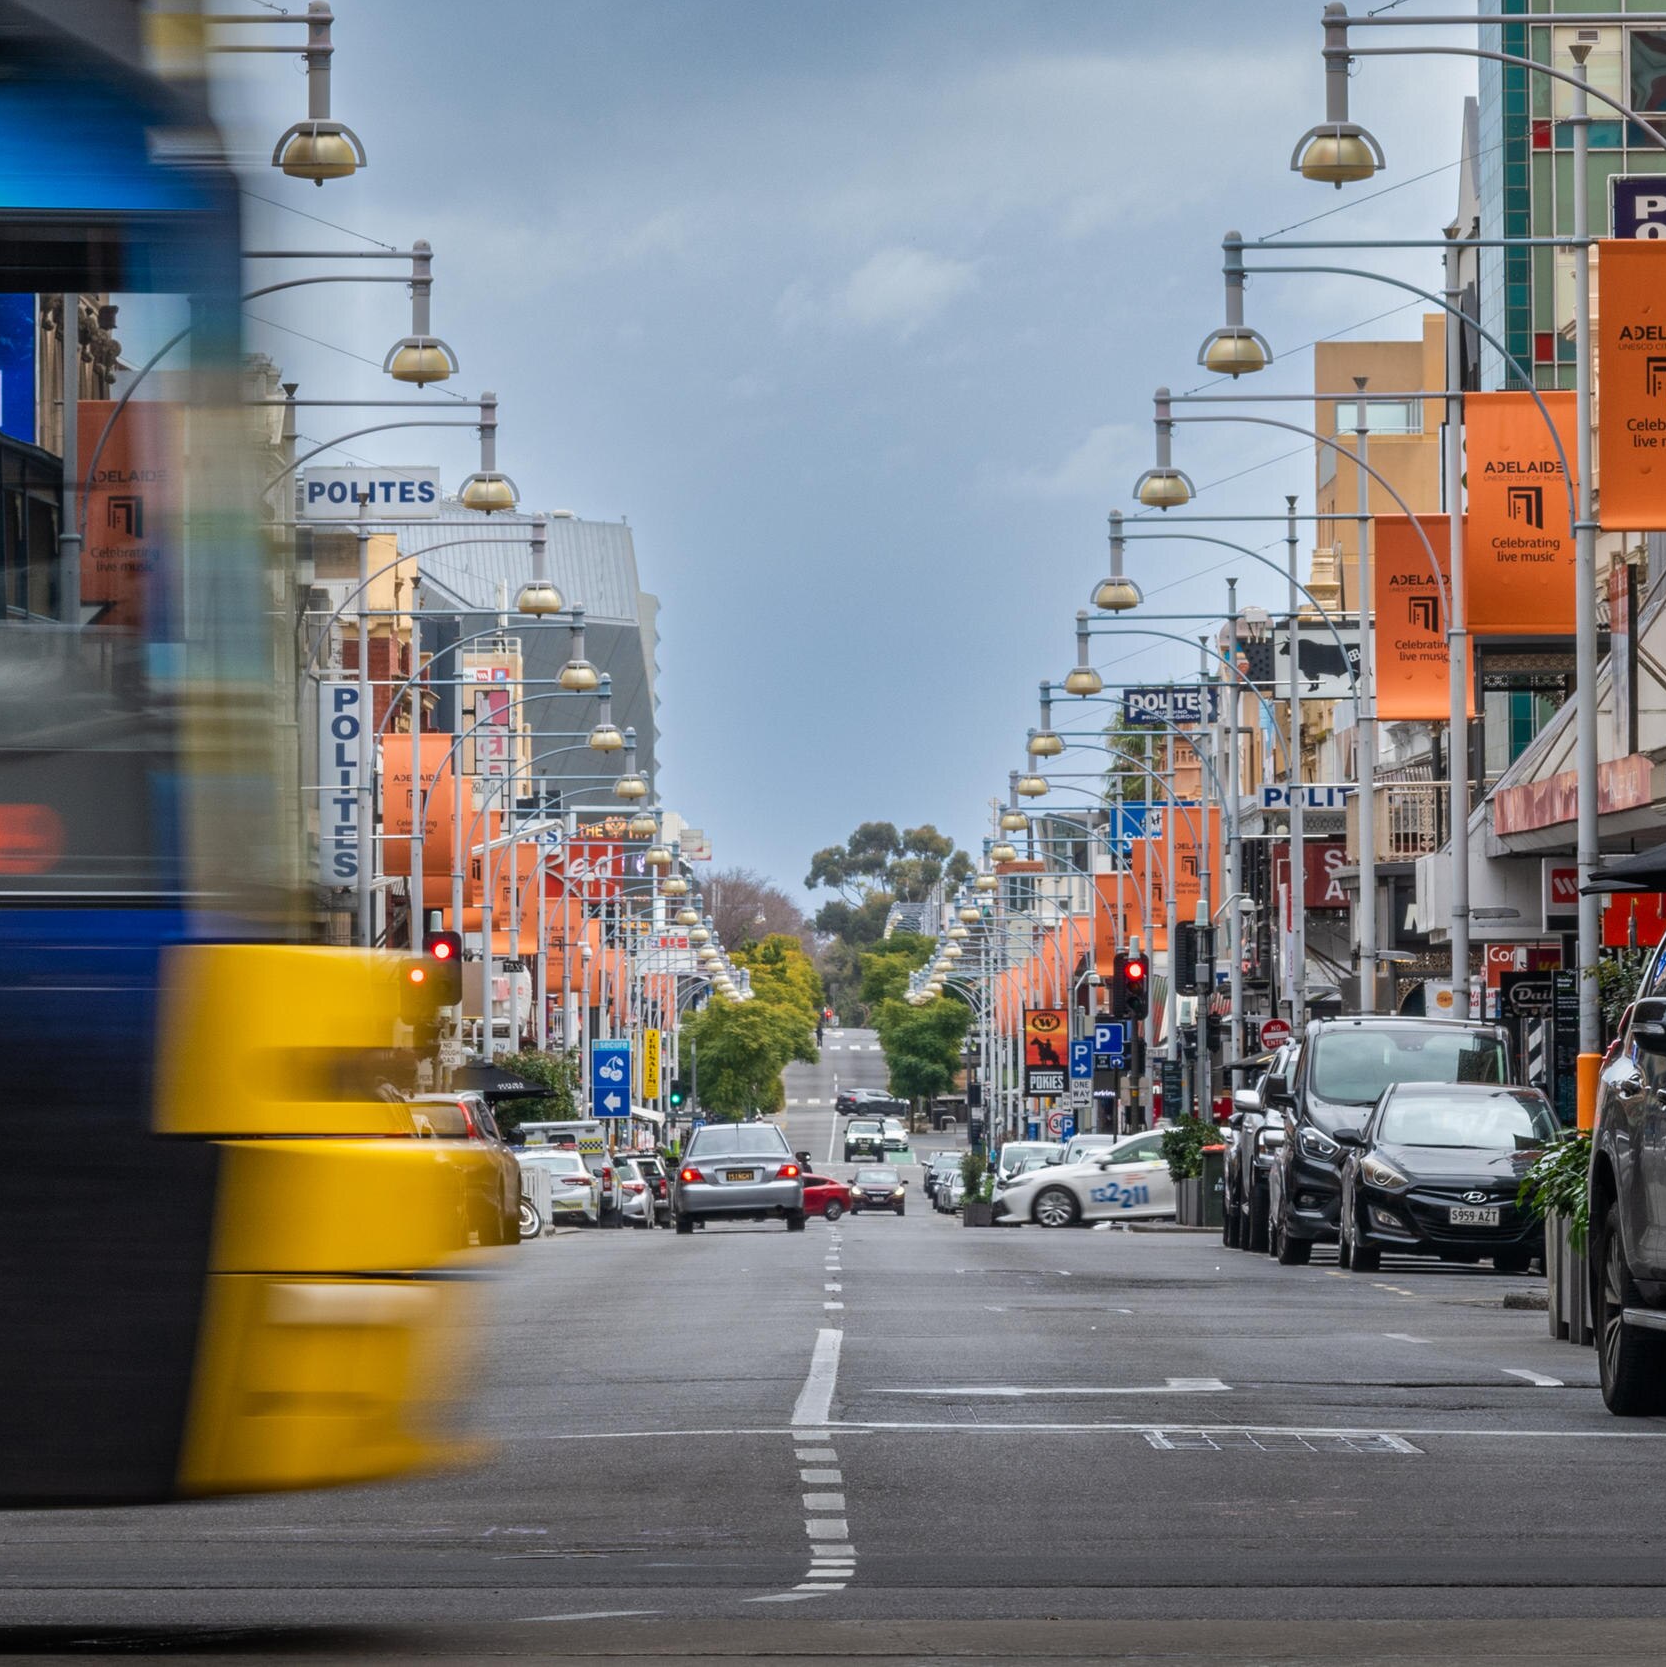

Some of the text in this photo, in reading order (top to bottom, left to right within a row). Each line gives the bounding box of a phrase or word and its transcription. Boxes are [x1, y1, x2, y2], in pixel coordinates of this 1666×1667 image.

[1633, 434, 1658, 448] live
[1484, 461, 1564, 473] ADELAIDE
[308, 481, 436, 504] POLITES
[1491, 537, 1561, 551] Celebrating
[91, 546, 161, 561] Celebrating
[1497, 551, 1555, 562] live music
[1399, 651, 1417, 662] live
[331, 687, 360, 878] POLITES
[1270, 1024, 1281, 1032] NO
[1095, 1028, 1111, 1050] P
[1074, 1045, 1088, 1060] P
[1030, 1075, 1064, 1089] POKIES
[1073, 1080, 1090, 1089] ONE
